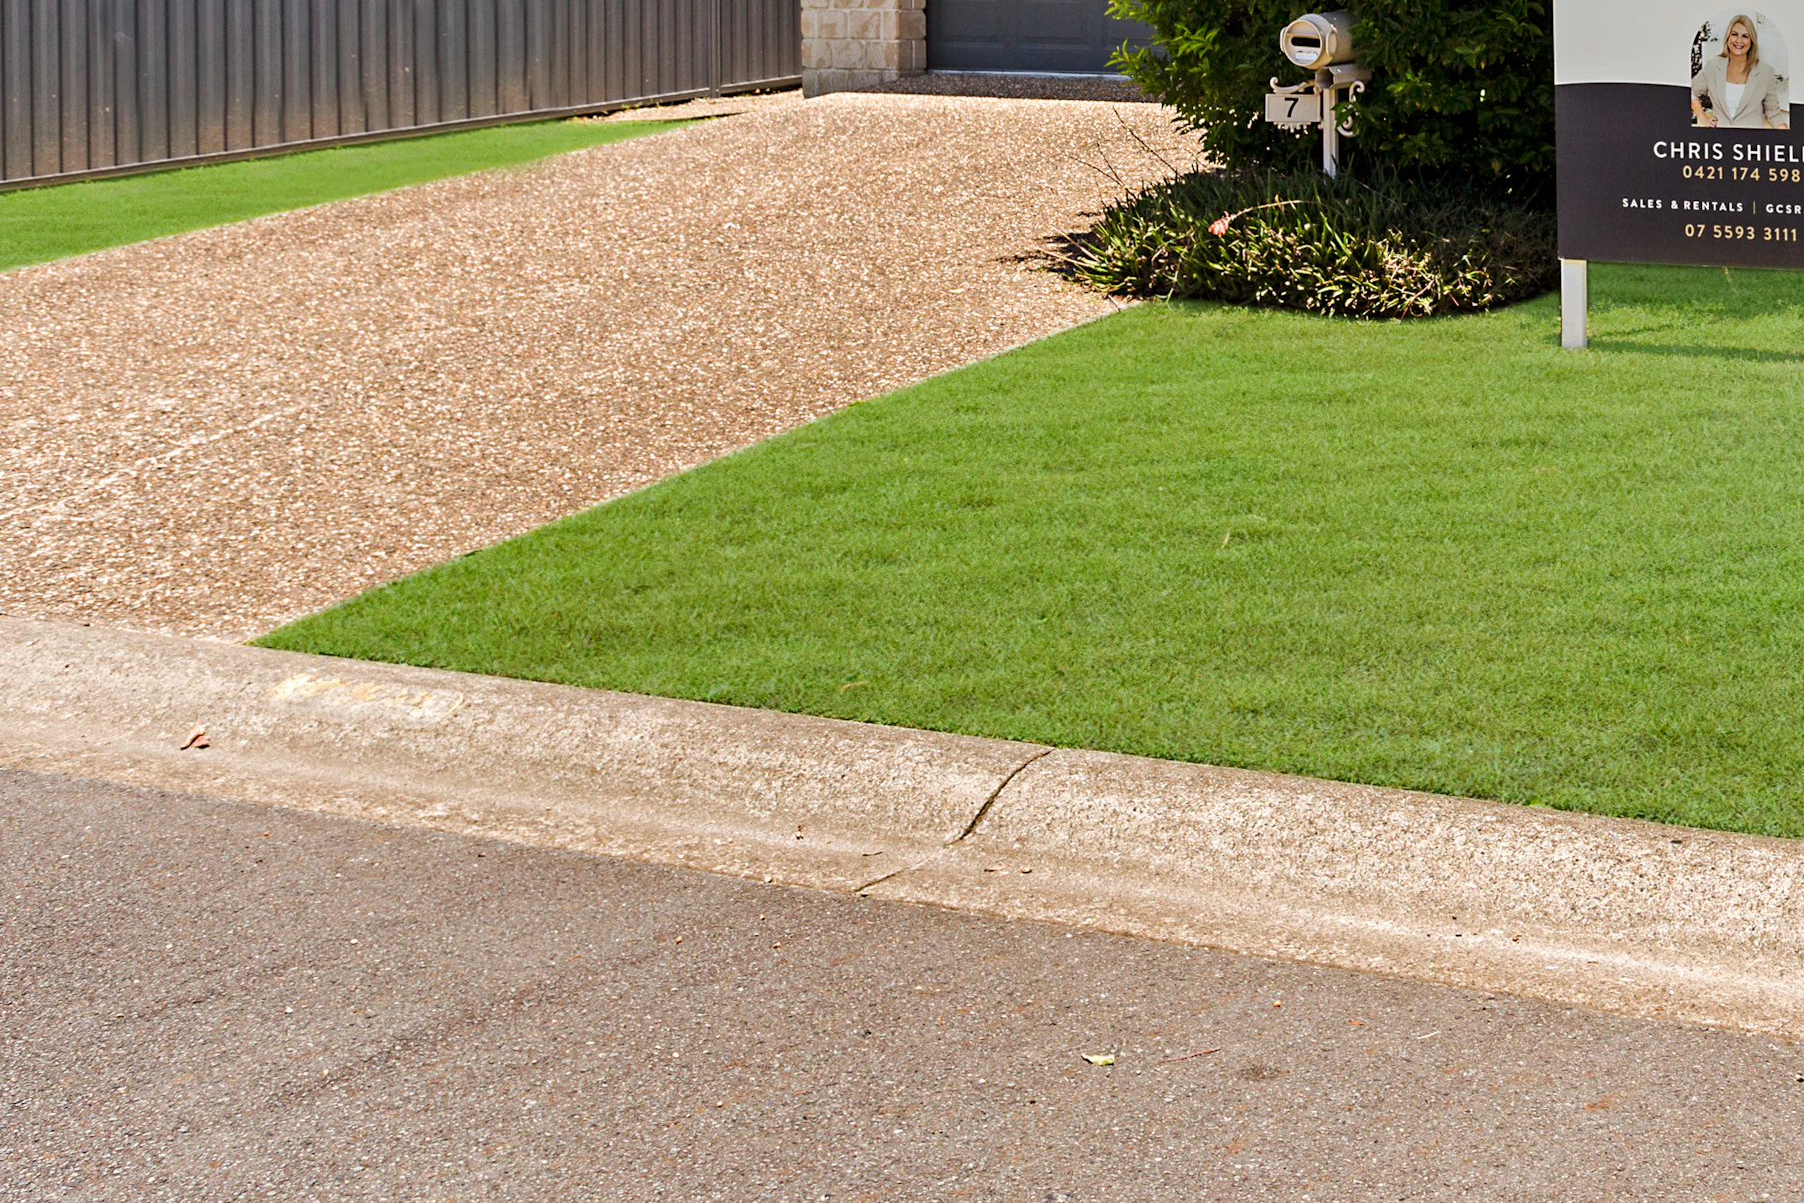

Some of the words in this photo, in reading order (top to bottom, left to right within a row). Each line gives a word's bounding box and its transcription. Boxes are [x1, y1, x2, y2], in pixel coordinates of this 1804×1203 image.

[1284, 97, 1299, 117] 7
[1653, 141, 1724, 161] CHRIS
[1682, 165, 1724, 180] 0421
[1731, 167, 1760, 182] 174
[1768, 168, 1801, 183] 598
[1622, 198, 1663, 209] SALES
[1670, 199, 1679, 210] &
[1683, 200, 1744, 213] RENTALS
[1684, 224, 1705, 238] 07
[1713, 225, 1755, 240] 5593
[1763, 227, 1798, 242] 3111
